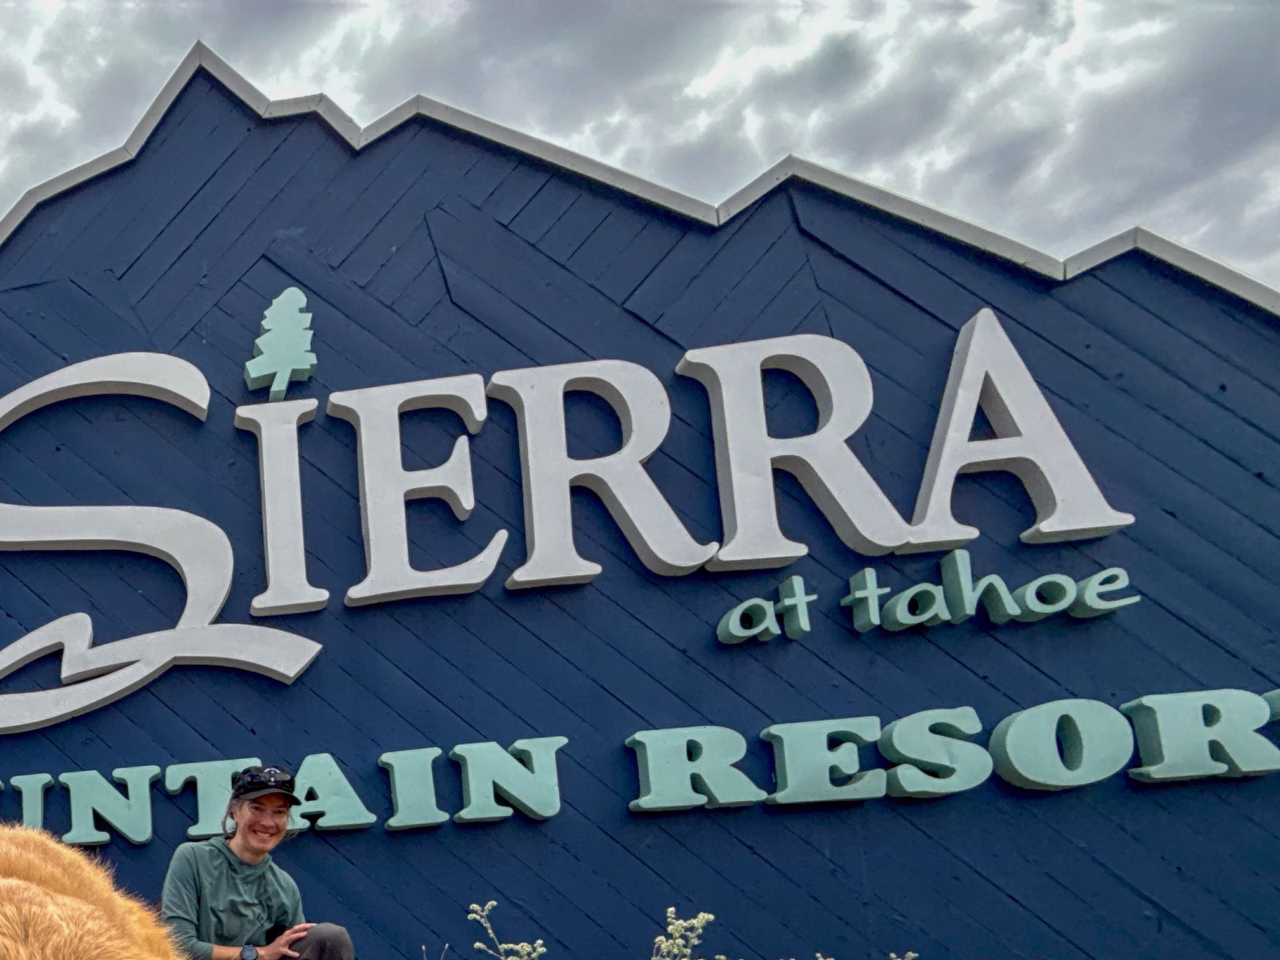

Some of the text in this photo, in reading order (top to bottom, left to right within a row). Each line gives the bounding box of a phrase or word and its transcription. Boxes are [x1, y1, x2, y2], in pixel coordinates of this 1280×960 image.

[717, 549, 1141, 644] at tahoe
[624, 688, 1280, 813] RESOR
